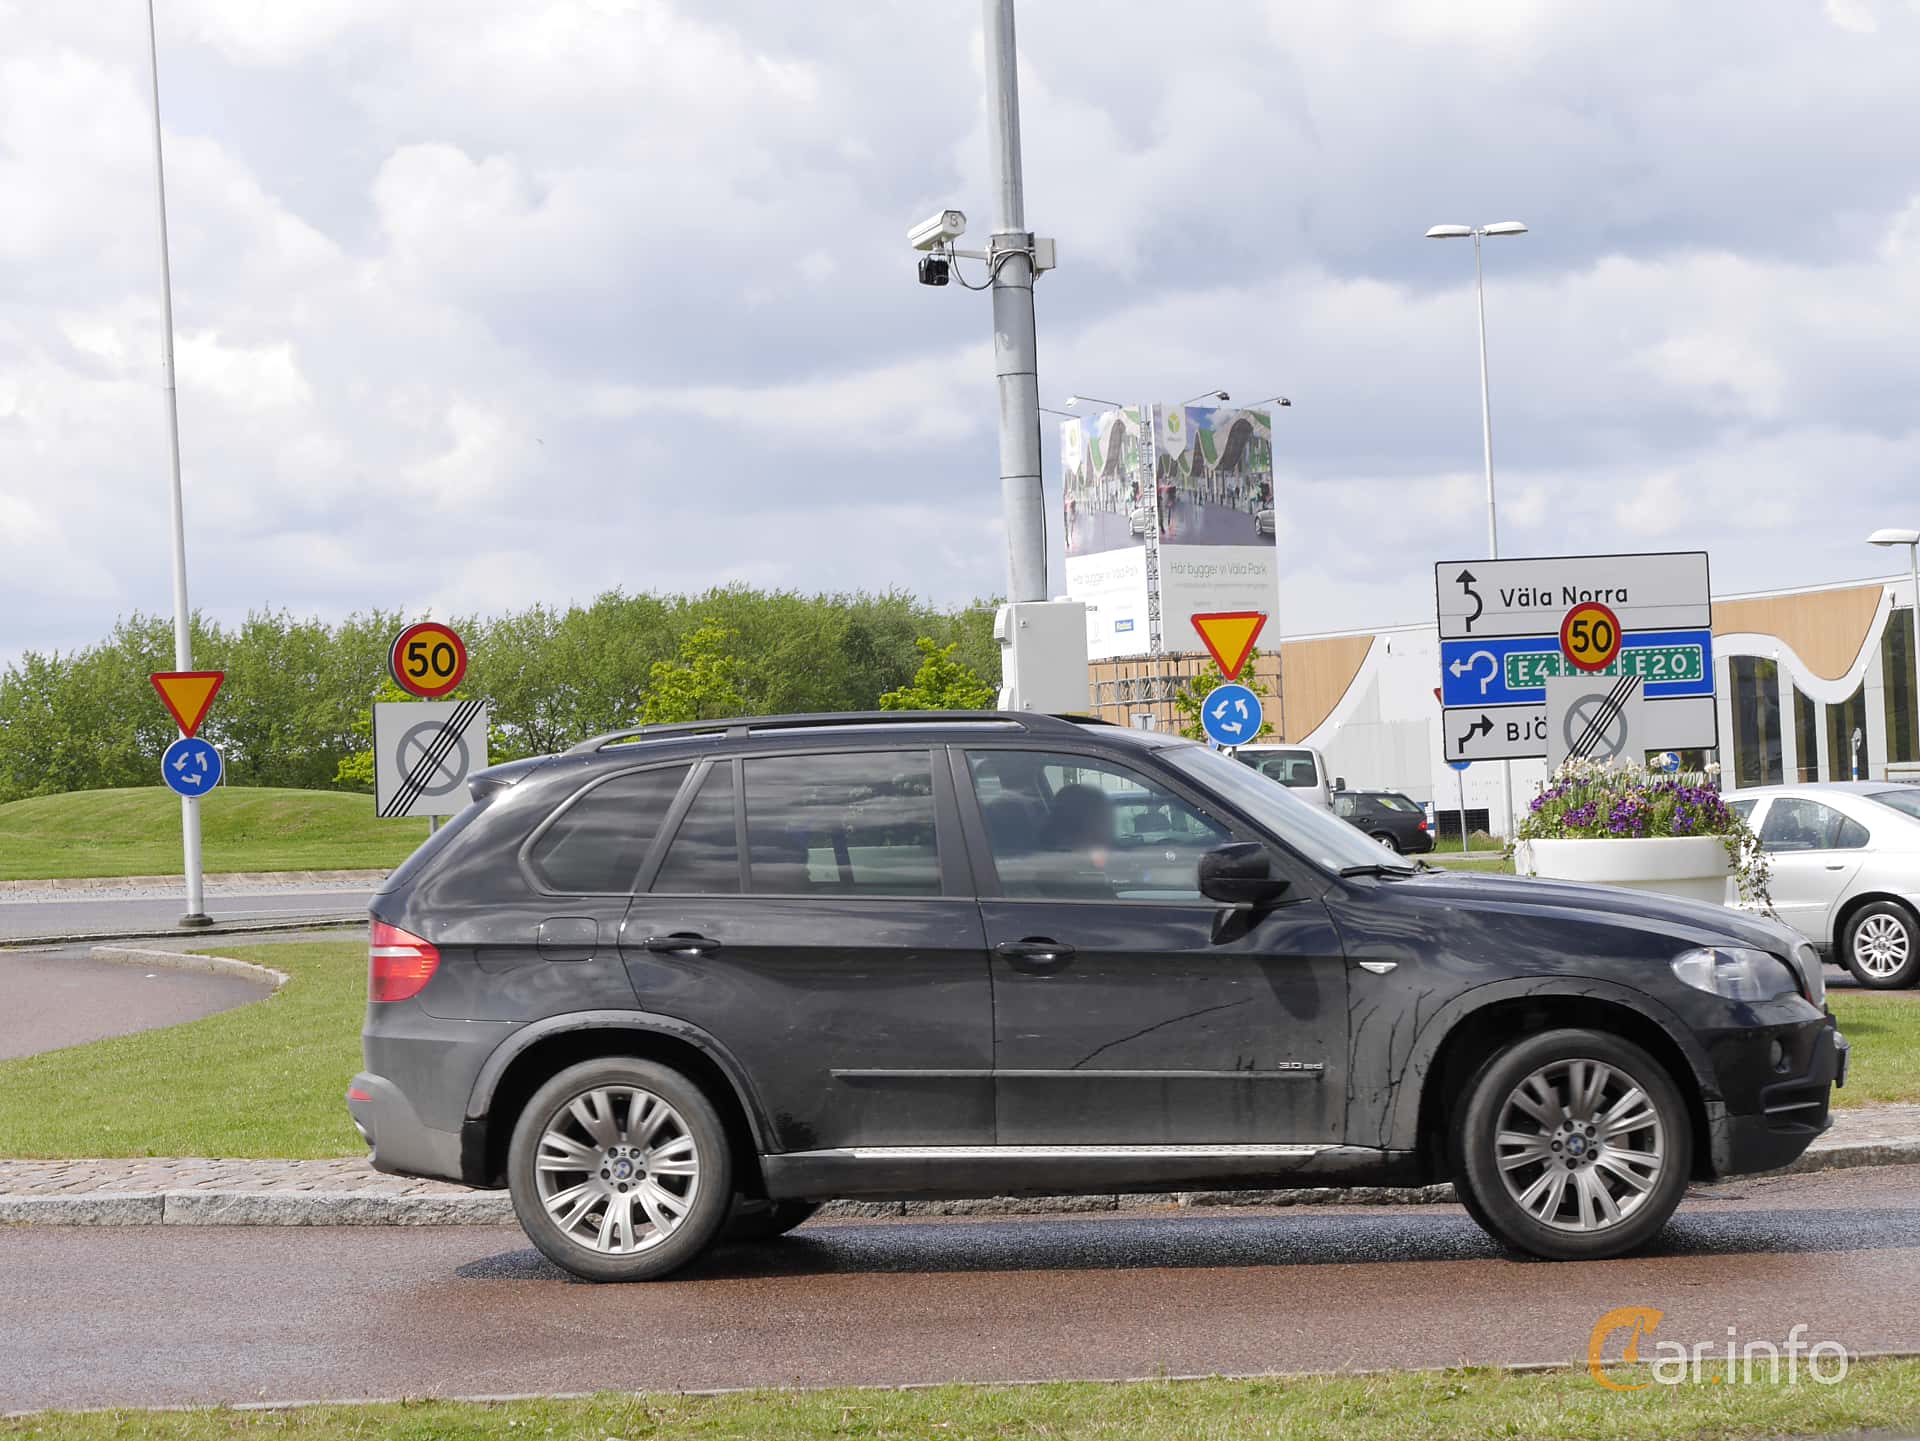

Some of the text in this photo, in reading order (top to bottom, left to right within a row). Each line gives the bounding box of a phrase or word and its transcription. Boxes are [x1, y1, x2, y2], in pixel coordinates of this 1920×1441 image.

[1500, 586, 1628, 607] Väla Norra
[1572, 620, 1613, 653] 50
[408, 642, 456, 678] 50
[1636, 654, 1687, 675] E20
